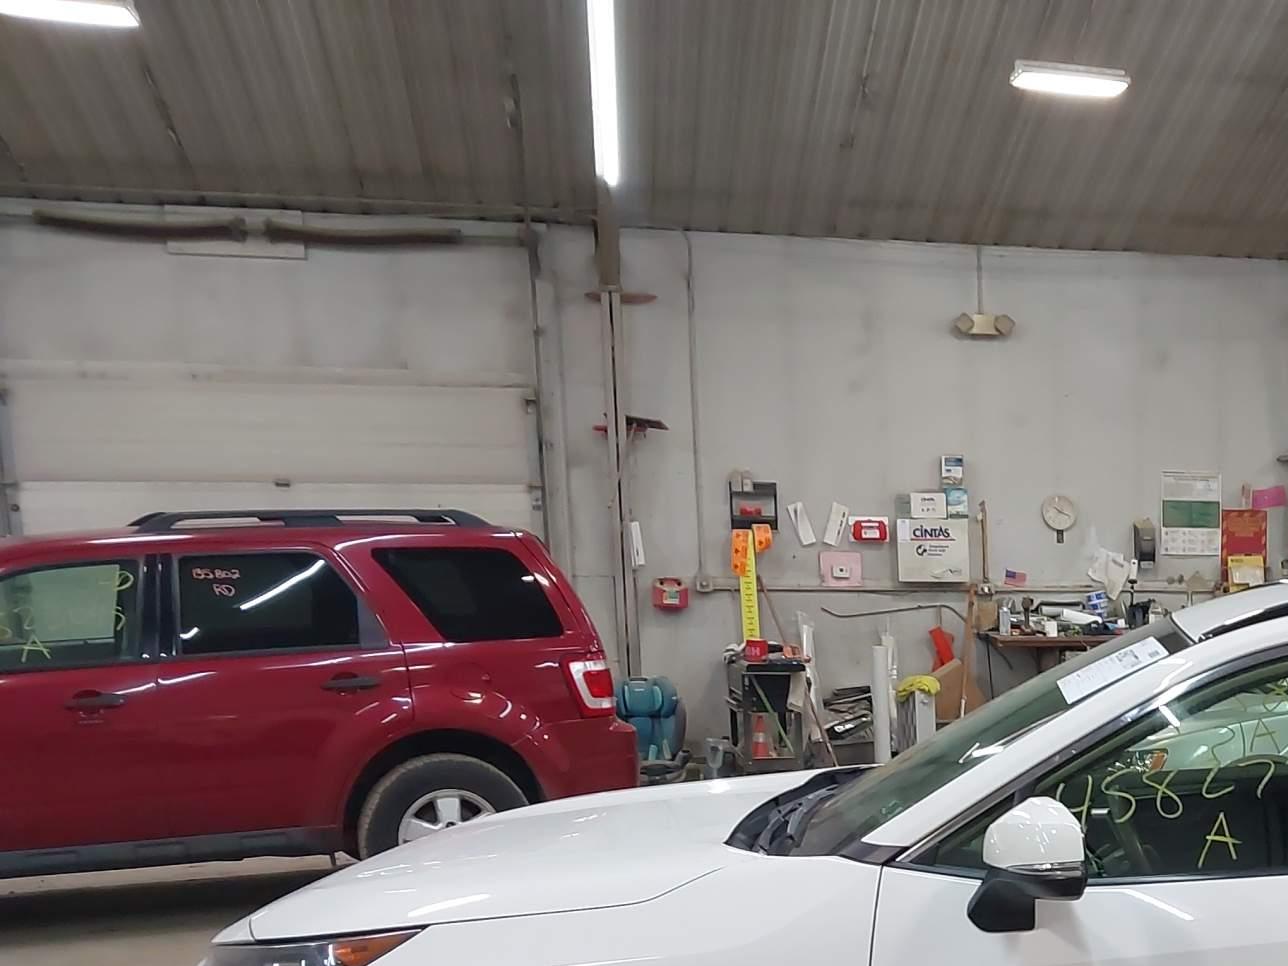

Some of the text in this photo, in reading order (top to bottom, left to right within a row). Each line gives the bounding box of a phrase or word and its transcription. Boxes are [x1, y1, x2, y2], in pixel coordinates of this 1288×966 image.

[912, 525, 951, 539] CINTAS
[21, 632, 51, 663] A
[1198, 811, 1243, 869] A
